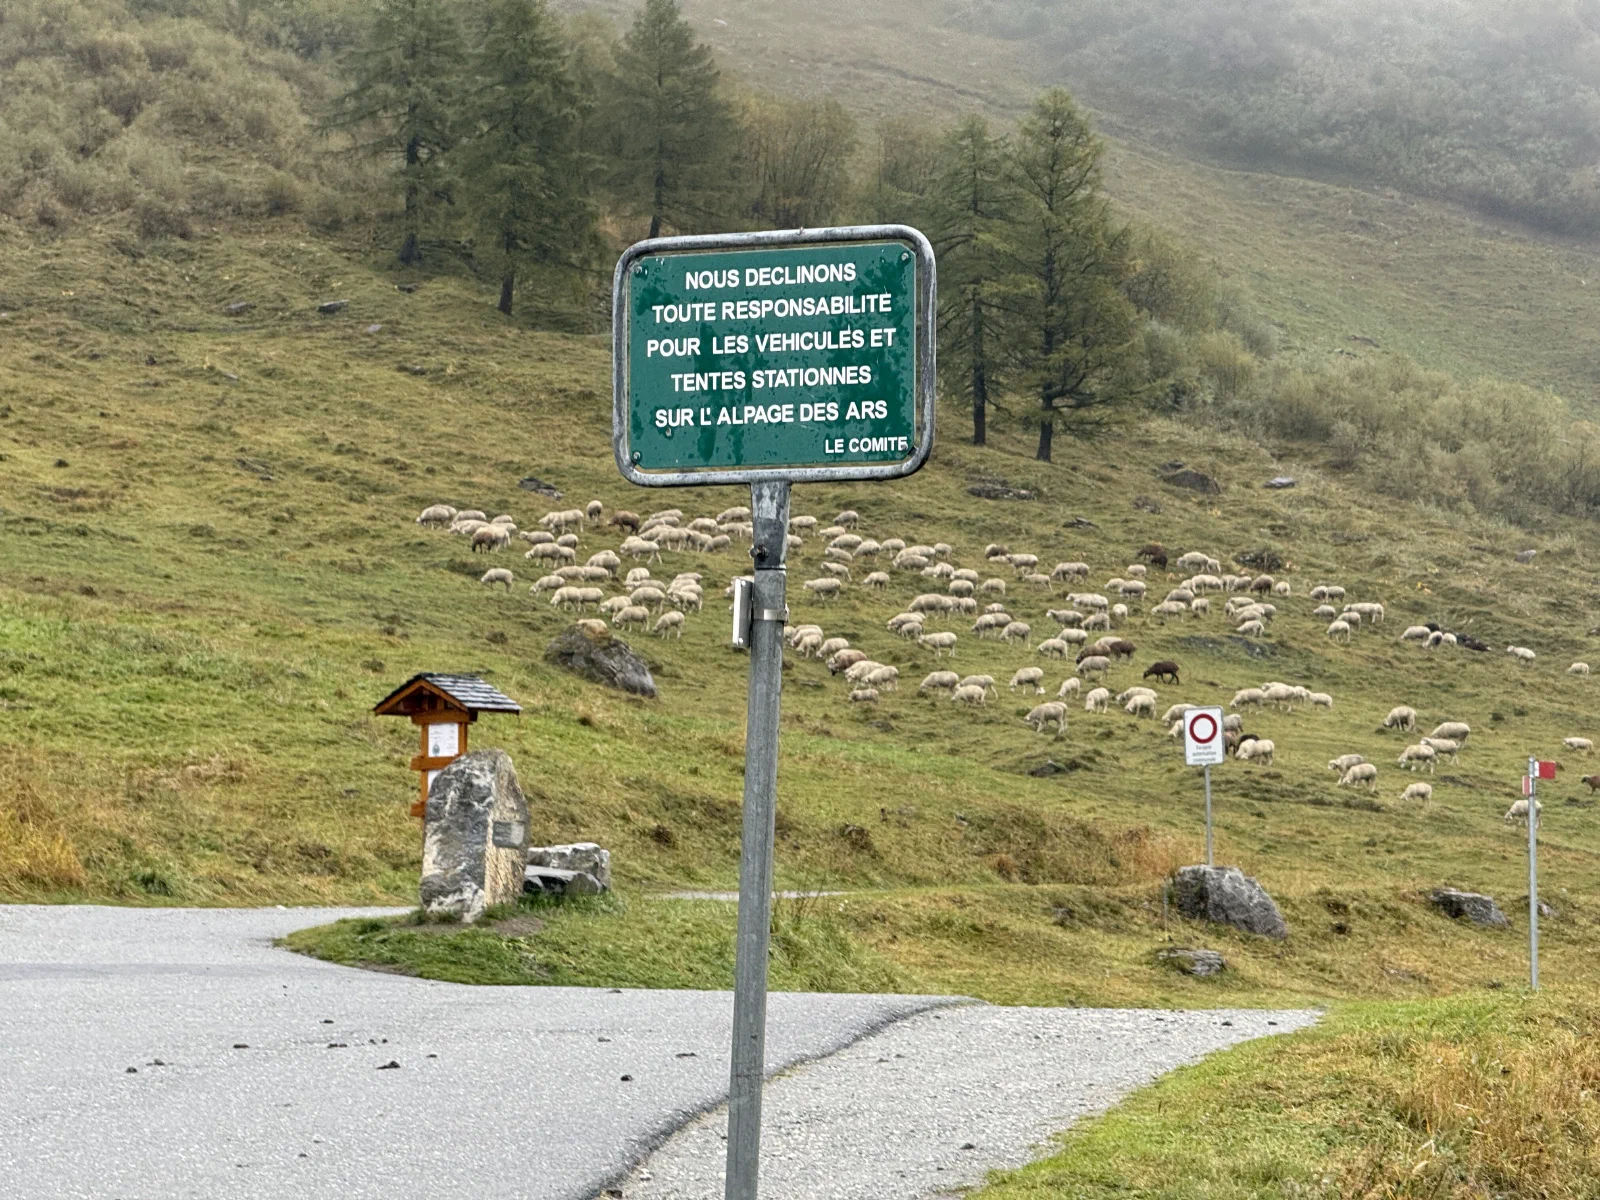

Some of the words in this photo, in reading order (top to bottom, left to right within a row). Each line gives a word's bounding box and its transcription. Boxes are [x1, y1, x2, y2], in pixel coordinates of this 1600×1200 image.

[685, 269, 740, 290] NOUS
[745, 262, 857, 288] DECLINONS
[651, 302, 717, 324] TOUTE
[721, 294, 892, 321] RESPONSABILITE
[647, 336, 701, 358] POUR
[712, 334, 749, 355] LES
[754, 328, 865, 353] VEHICULES
[870, 327, 897, 348] ET
[670, 370, 746, 392] TENTES
[751, 365, 872, 390] STATIONNES
[655, 407, 695, 428] SUR
[716, 403, 795, 425] ALPAGE
[799, 402, 839, 422] DES
[845, 400, 888, 421] ARS
[824, 438, 845, 454] LE
[848, 436, 909, 453] COMITE
